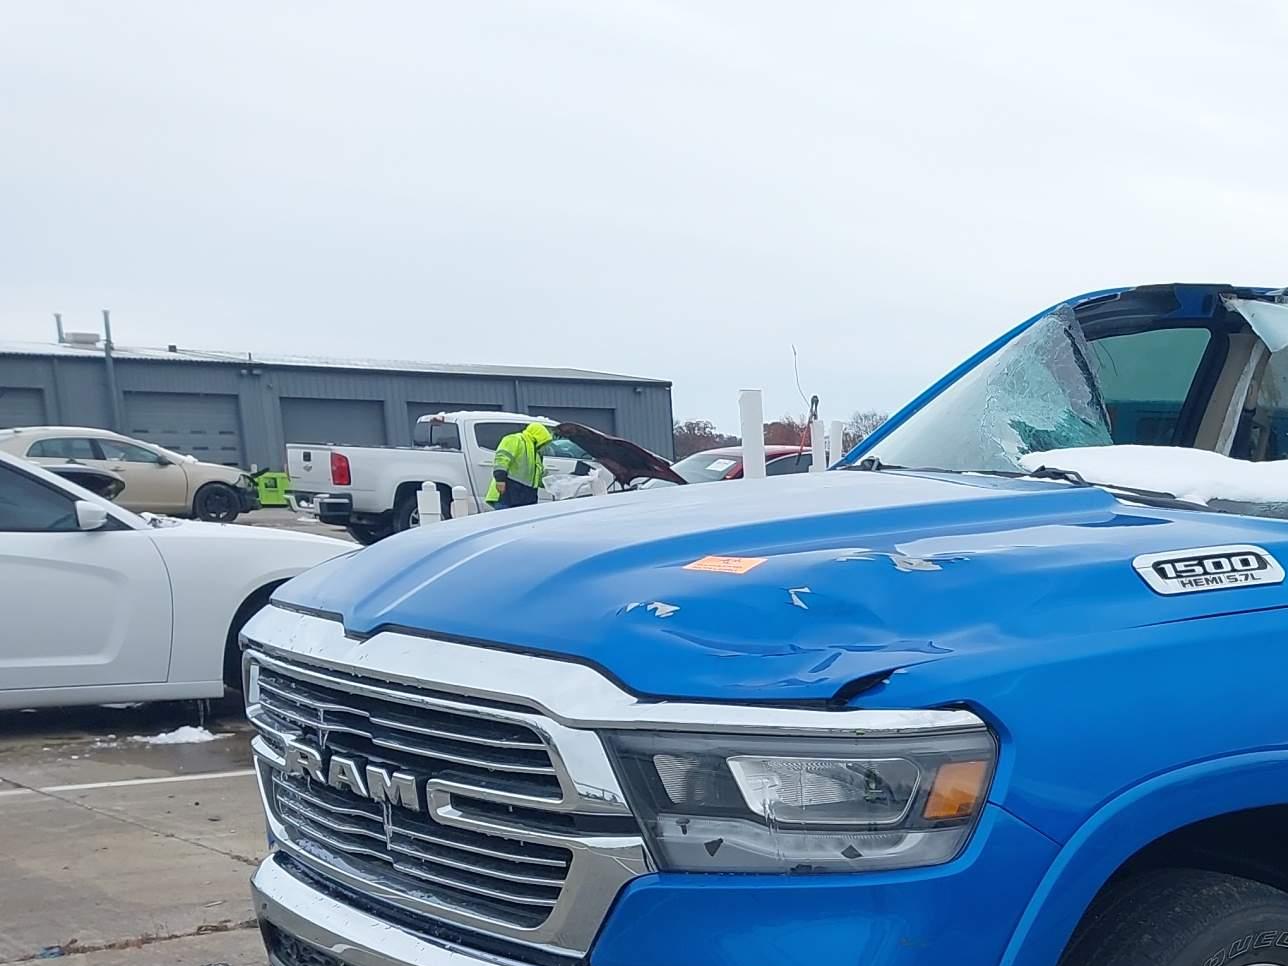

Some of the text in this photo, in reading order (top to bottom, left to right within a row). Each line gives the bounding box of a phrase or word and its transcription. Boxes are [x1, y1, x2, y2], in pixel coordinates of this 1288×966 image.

[1157, 554, 1260, 579] 1500
[1180, 573, 1262, 588] HEMI 5.7L
[285, 739, 420, 812] RAM
